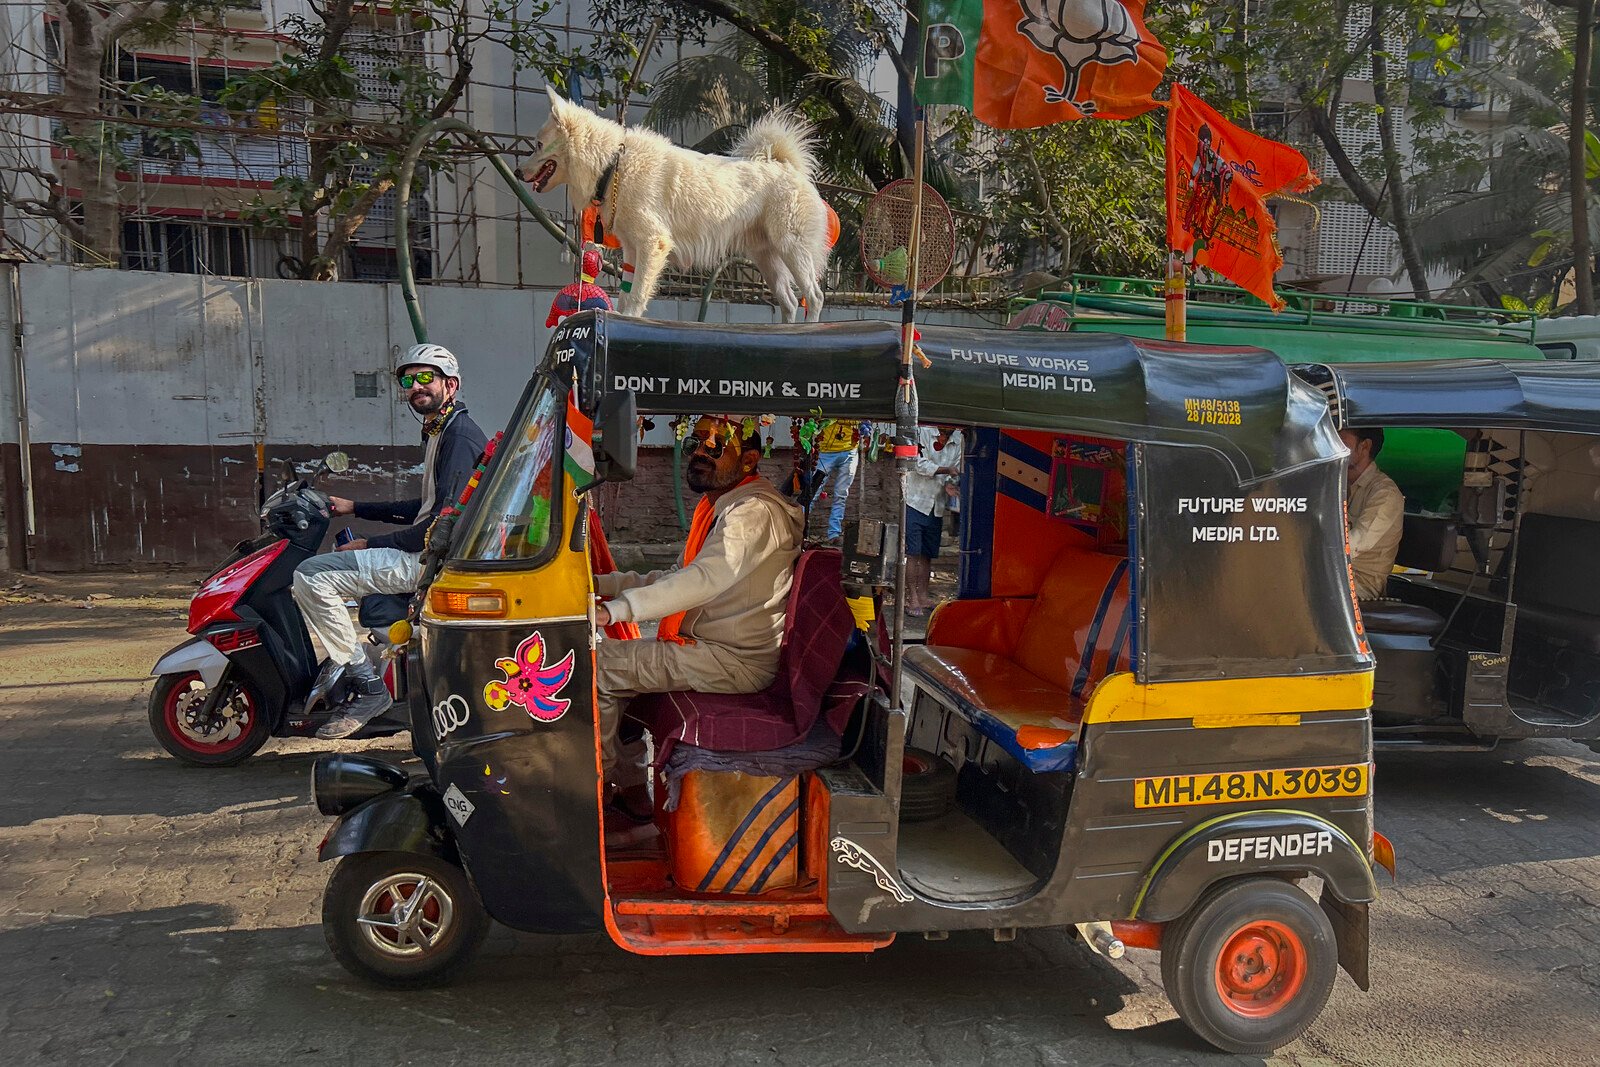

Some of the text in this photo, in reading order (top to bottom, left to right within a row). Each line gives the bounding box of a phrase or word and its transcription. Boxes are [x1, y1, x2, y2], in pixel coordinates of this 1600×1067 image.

[923, 23, 966, 79] P
[556, 348, 576, 365] TOP
[950, 348, 1090, 372] FUTURE WORKS
[614, 375, 862, 399] DON'T MIX DRINK & DRIVE
[1003, 372, 1097, 393] MEDIA LTD.
[1178, 497, 1308, 514] FUTURE WORKS
[1192, 525, 1280, 542] MEDIA LTD.
[1144, 767, 1361, 805] MH.48.N.3039
[447, 797, 468, 813] CNG
[1207, 832, 1333, 862] DEFENDER
